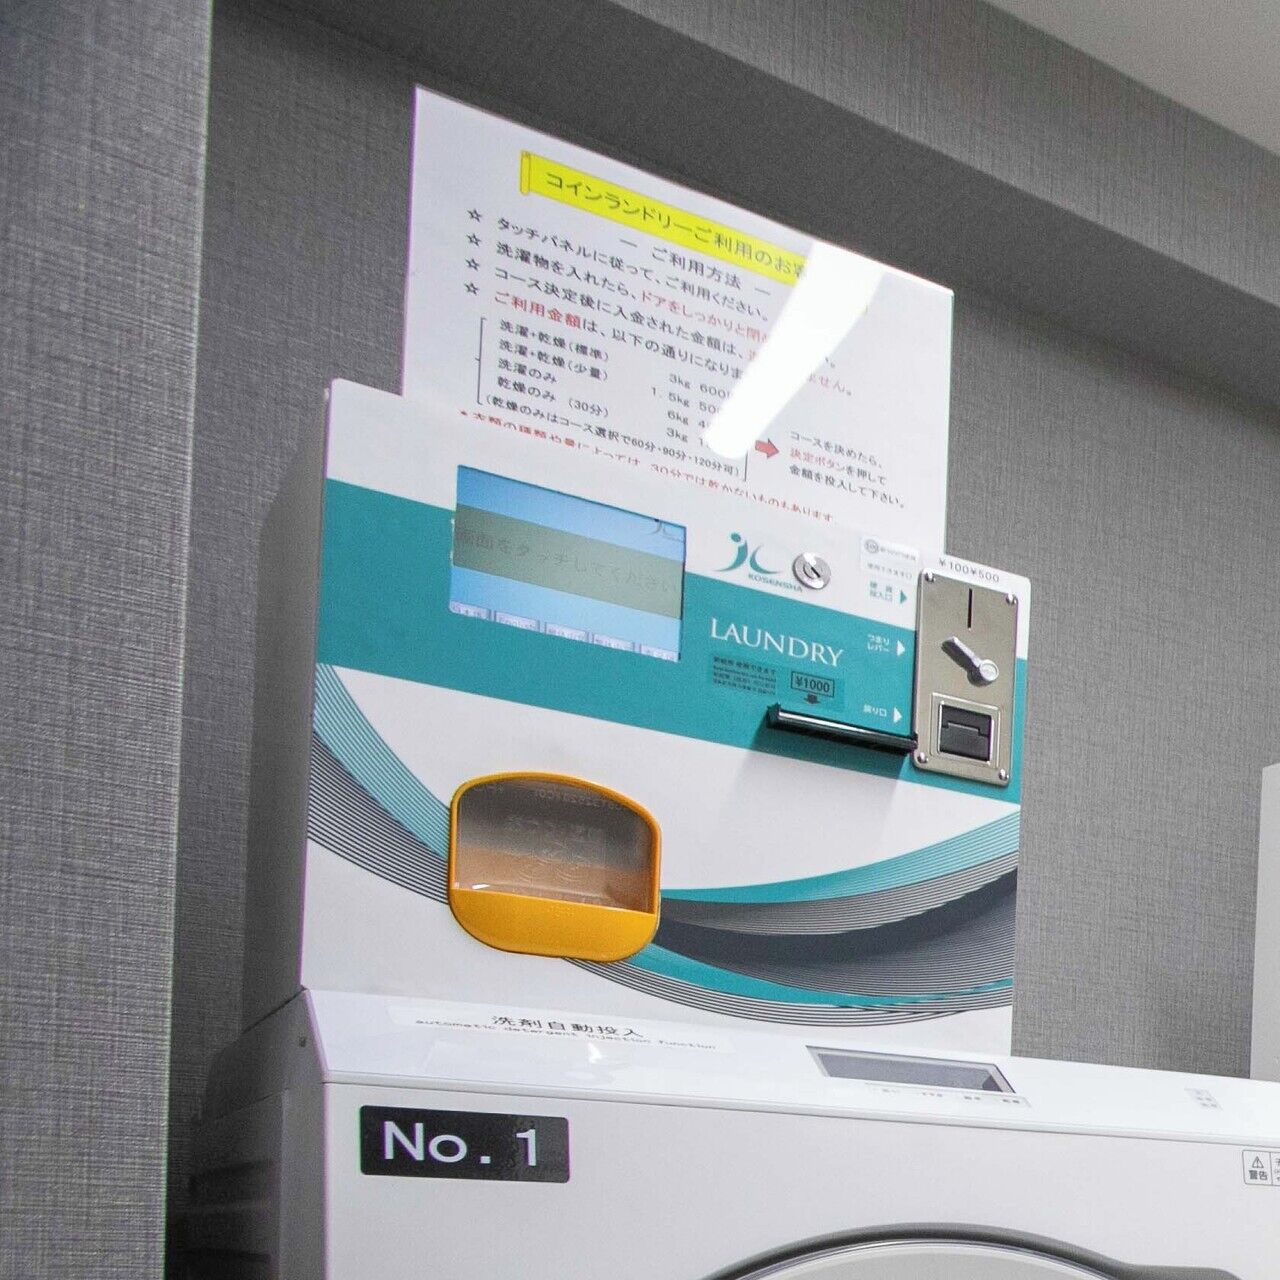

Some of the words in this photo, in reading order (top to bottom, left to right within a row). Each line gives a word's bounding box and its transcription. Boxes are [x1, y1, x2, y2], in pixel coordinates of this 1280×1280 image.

[652, 247, 741, 289] ご利用方法
[498, 358, 557, 385] 洗濯のみ
[667, 409, 689, 426] 6kg
[669, 373, 691, 389] 3kg
[699, 383, 731, 400] 600
[666, 426, 688, 444] 3kg
[711, 616, 844, 668] LAUNDRY
[794, 674, 831, 693] ¥1000
[492, 1014, 644, 1039] 洗剤自動投入
